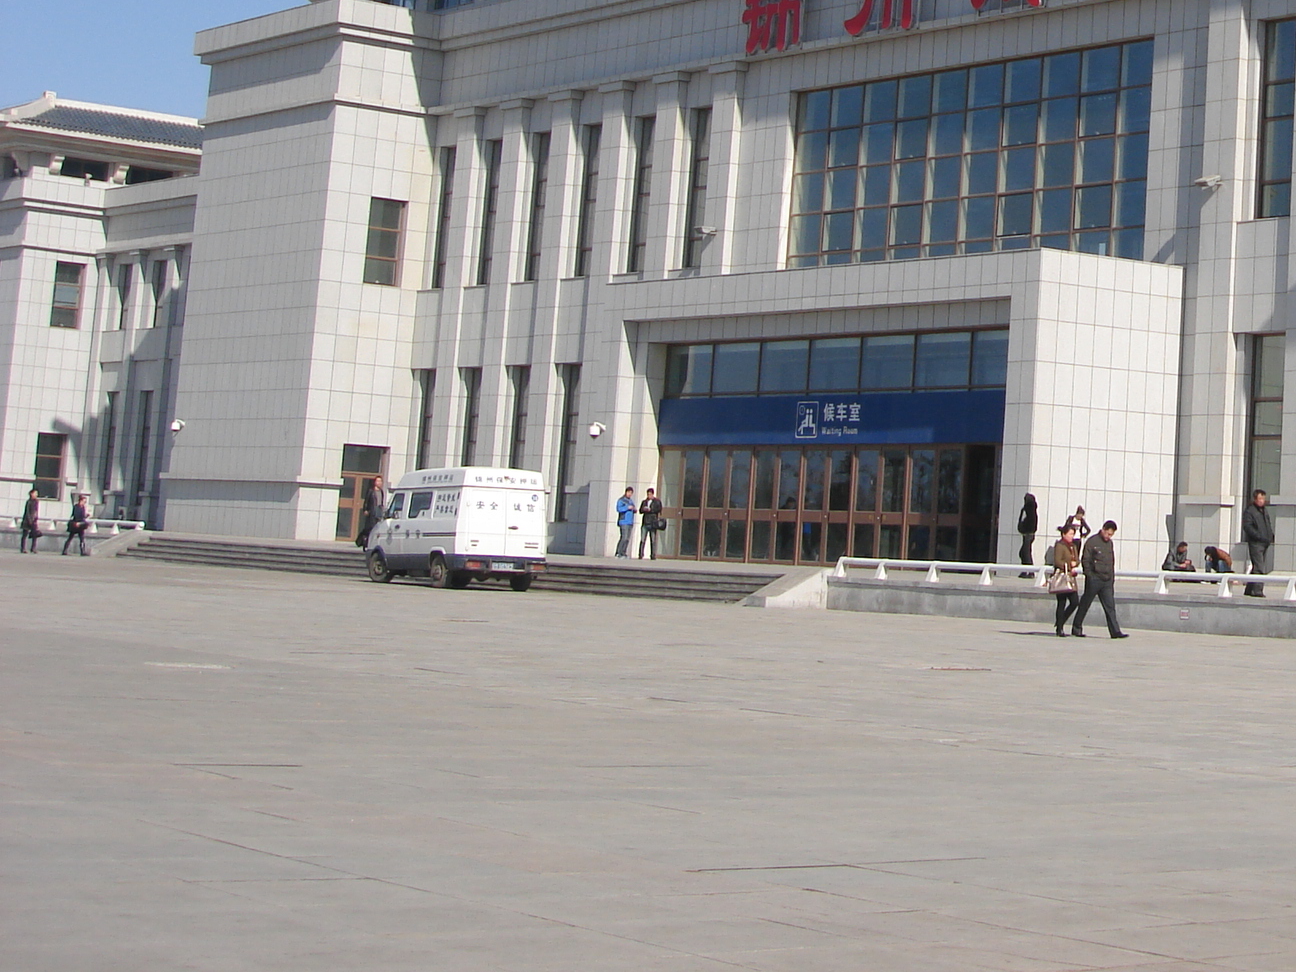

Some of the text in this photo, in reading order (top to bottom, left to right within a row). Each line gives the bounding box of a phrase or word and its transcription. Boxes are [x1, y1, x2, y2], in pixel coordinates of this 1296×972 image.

[823, 402, 861, 422] 候车室
[821, 425, 858, 437] Waiting Room
[476, 500, 536, 512] 安全 诚信
